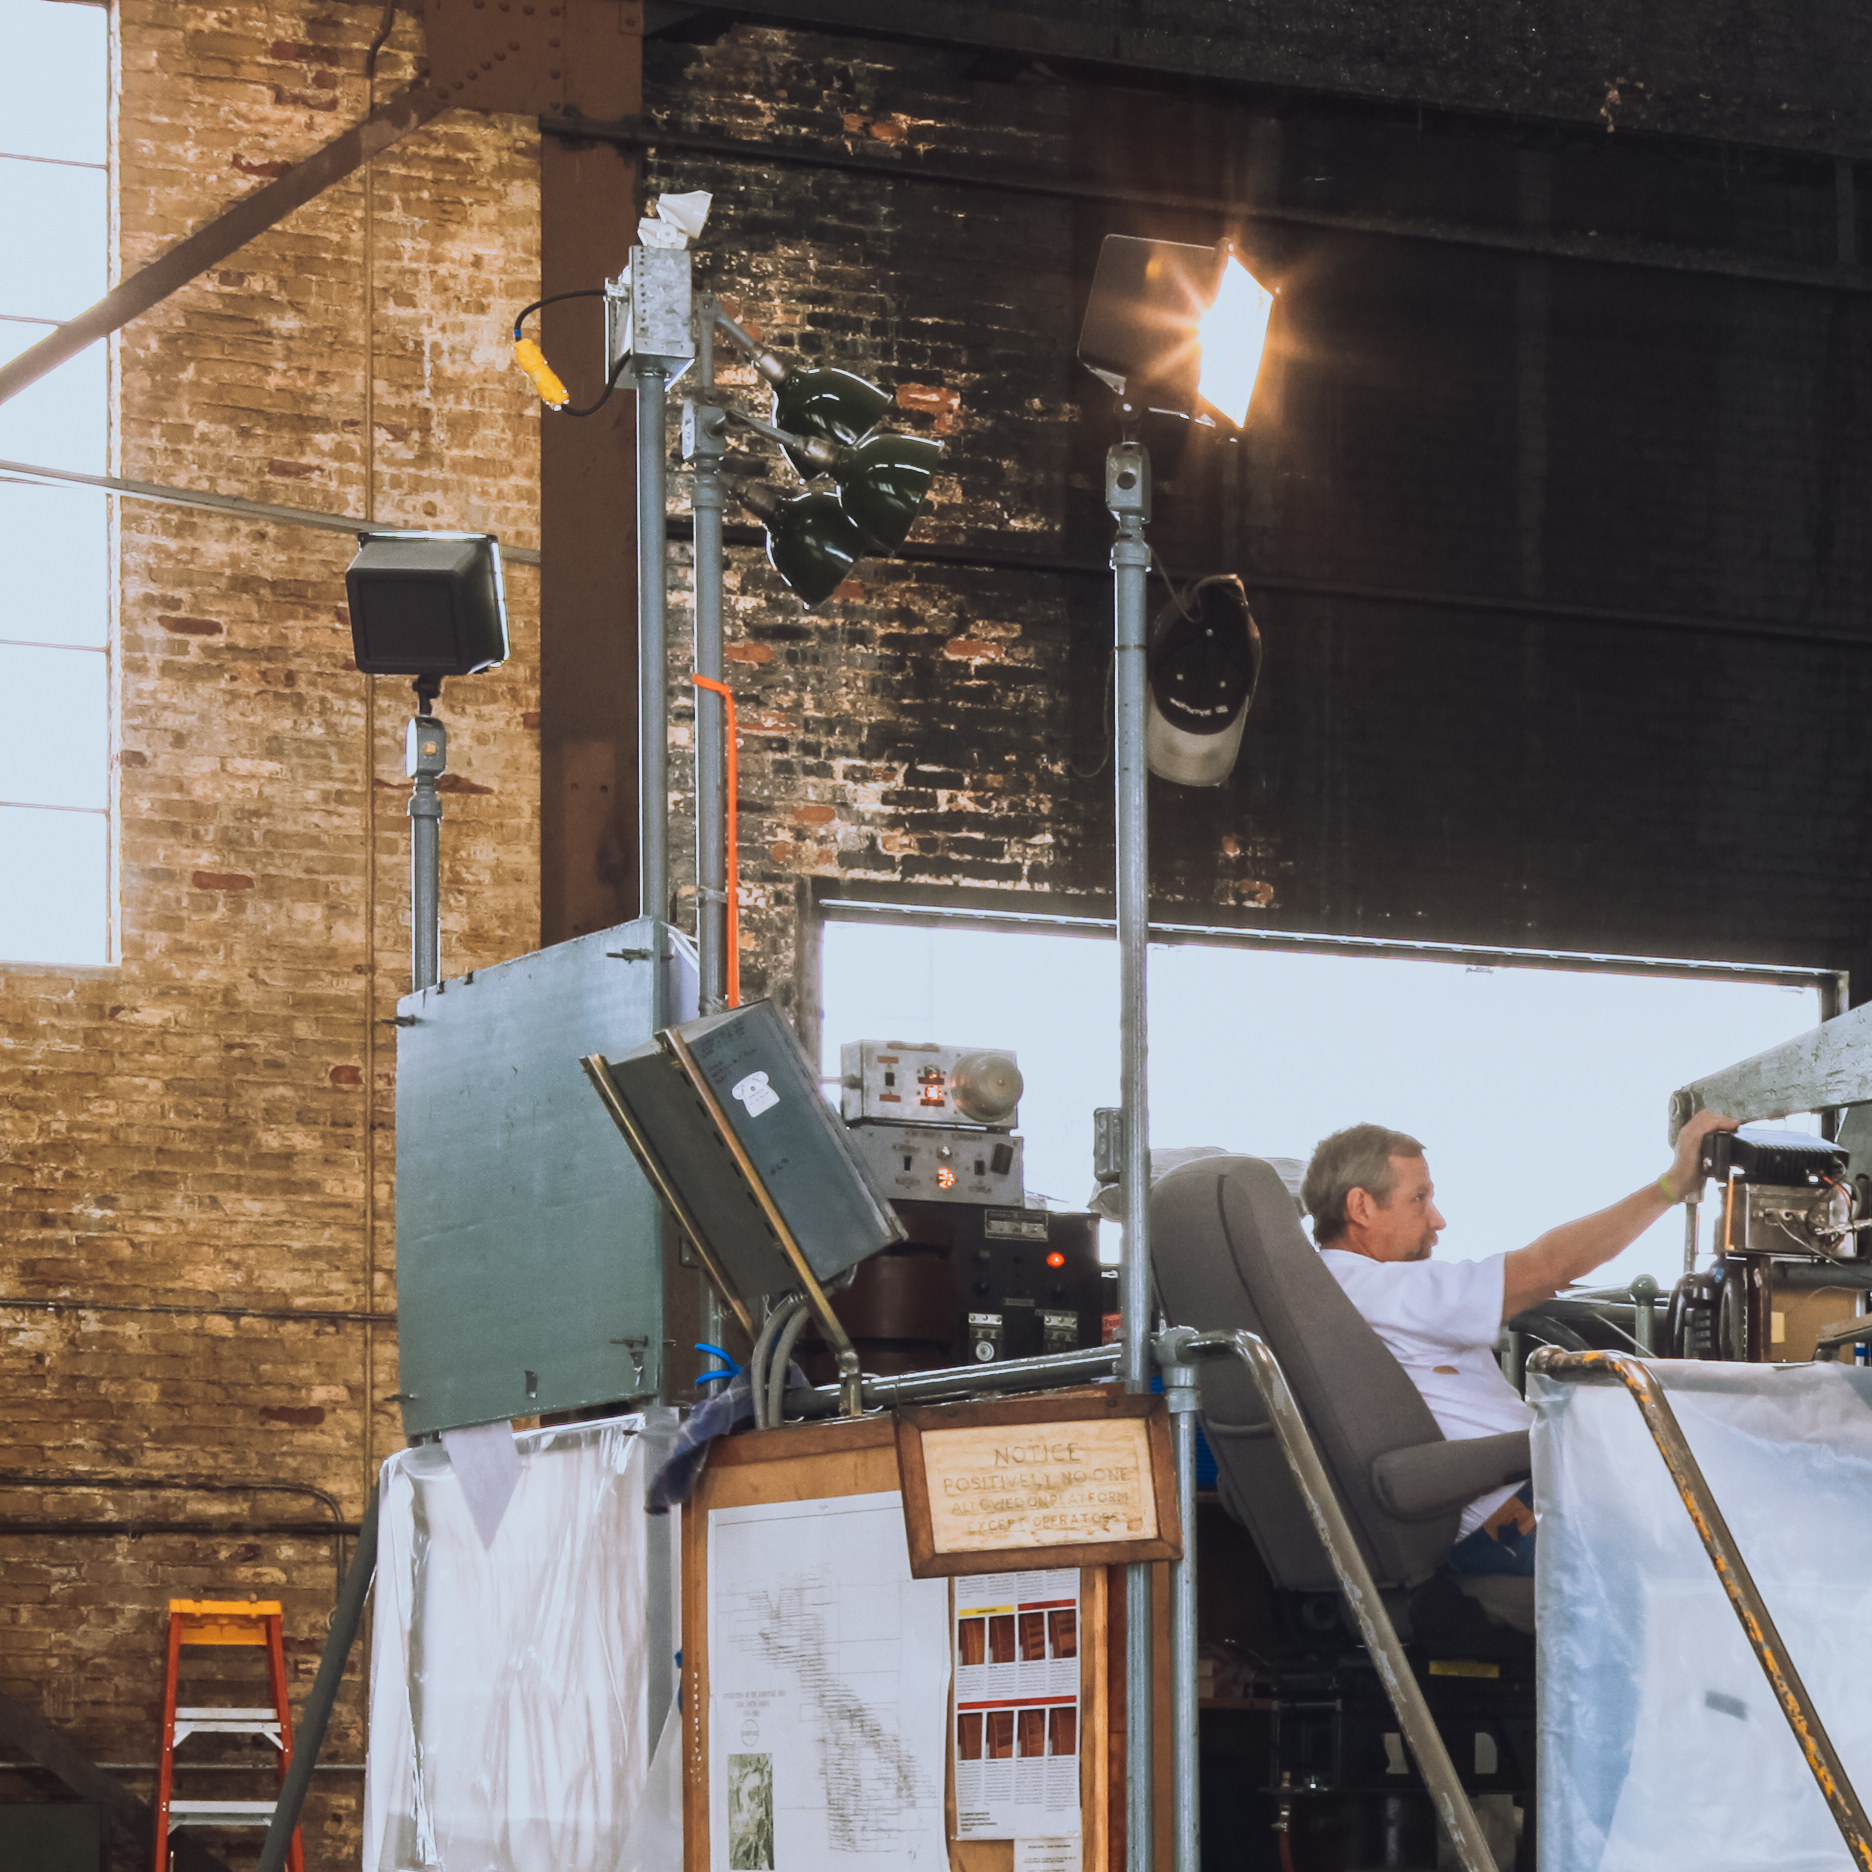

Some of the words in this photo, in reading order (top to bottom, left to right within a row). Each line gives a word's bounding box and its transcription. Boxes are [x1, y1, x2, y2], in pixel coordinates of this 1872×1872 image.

[994, 1442, 1081, 1467] NOTICE
[943, 1473, 1056, 1495] POSITIVELY
[1062, 1470, 1087, 1486] NO
[1093, 1467, 1130, 1482] ONE
[952, 1497, 1024, 1514] ALLOWED
[1050, 1493, 1129, 1508] PLATFORM
[967, 1517, 1025, 1532] EXCEPT
